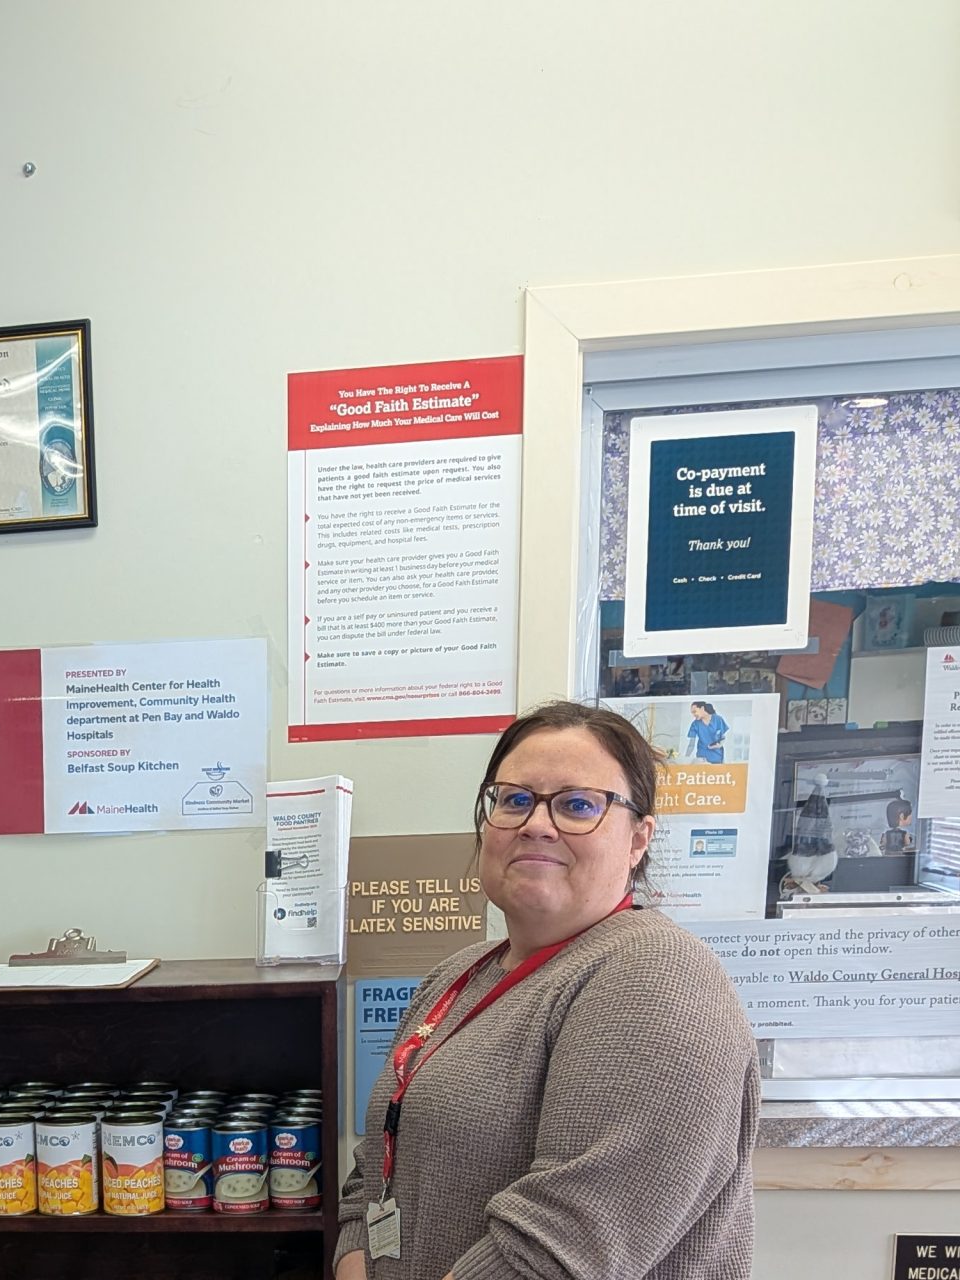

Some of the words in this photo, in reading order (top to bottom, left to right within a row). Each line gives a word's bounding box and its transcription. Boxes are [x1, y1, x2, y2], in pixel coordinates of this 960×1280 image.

[339, 390, 354, 398] You
[356, 389, 375, 397] Have
[378, 387, 393, 395] The
[395, 385, 416, 395] Right
[419, 384, 429, 392] To
[431, 382, 461, 391] Receive
[375, 400, 408, 413] Faith
[310, 421, 351, 433] Explaining
[353, 421, 369, 429] How
[371, 419, 392, 428] Much
[394, 418, 412, 426] Your
[414, 415, 443, 424] Medical
[445, 414, 462, 422] Care
[464, 412, 480, 420] Will
[482, 411, 499, 419] Cost
[677, 464, 766, 482] Co-payment
[689, 486, 702, 498] is
[706, 485, 733, 497] due
[737, 482, 751, 494] at
[673, 504, 706, 517] time
[710, 502, 725, 514] of
[729, 500, 765, 513] visit.
[689, 539, 724, 551] Thank
[727, 537, 751, 551] you!
[410, 645, 433, 654] picture
[444, 645, 458, 653] your
[66, 669, 112, 679] PRESENTED
[115, 669, 126, 677] BY
[66, 681, 129, 694] MaineHealth
[133, 681, 166, 691] Center
[169, 679, 184, 689] for
[186, 677, 220, 689] Health
[66, 697, 137, 710] Improvement,
[140, 695, 198, 708] Community
[202, 694, 235, 703] Health
[67, 712, 126, 727] department
[129, 713, 139, 722] at
[142, 712, 161, 722] Pen
[164, 711, 182, 723] Bay
[185, 710, 204, 720] and
[207, 708, 239, 719] Waldo
[67, 730, 113, 742] Hospitals
[68, 749, 117, 759] SPONSORED
[119, 748, 130, 757] BY
[68, 762, 105, 773] Belfast
[108, 761, 135, 775] Soup
[139, 760, 179, 771] Kitchen
[676, 772, 736, 786] Patient,
[97, 803, 158, 814] MaineHealth
[353, 880, 409, 895] PLEASE
[417, 880, 455, 894] TELL
[460, 878, 480, 892] US
[372, 900, 384, 914] IF
[391, 899, 422, 913] YOU
[430, 898, 459, 912] ARE
[351, 918, 395, 933] LATEX
[403, 916, 481, 931] SENSITIVE
[757, 998, 809, 1008] moment.
[814, 996, 850, 1007] Thank
[853, 997, 874, 1009] you
[879, 996, 896, 1006] for
[900, 996, 926, 1007] your
[219, 1163, 263, 1171] Mushroom
